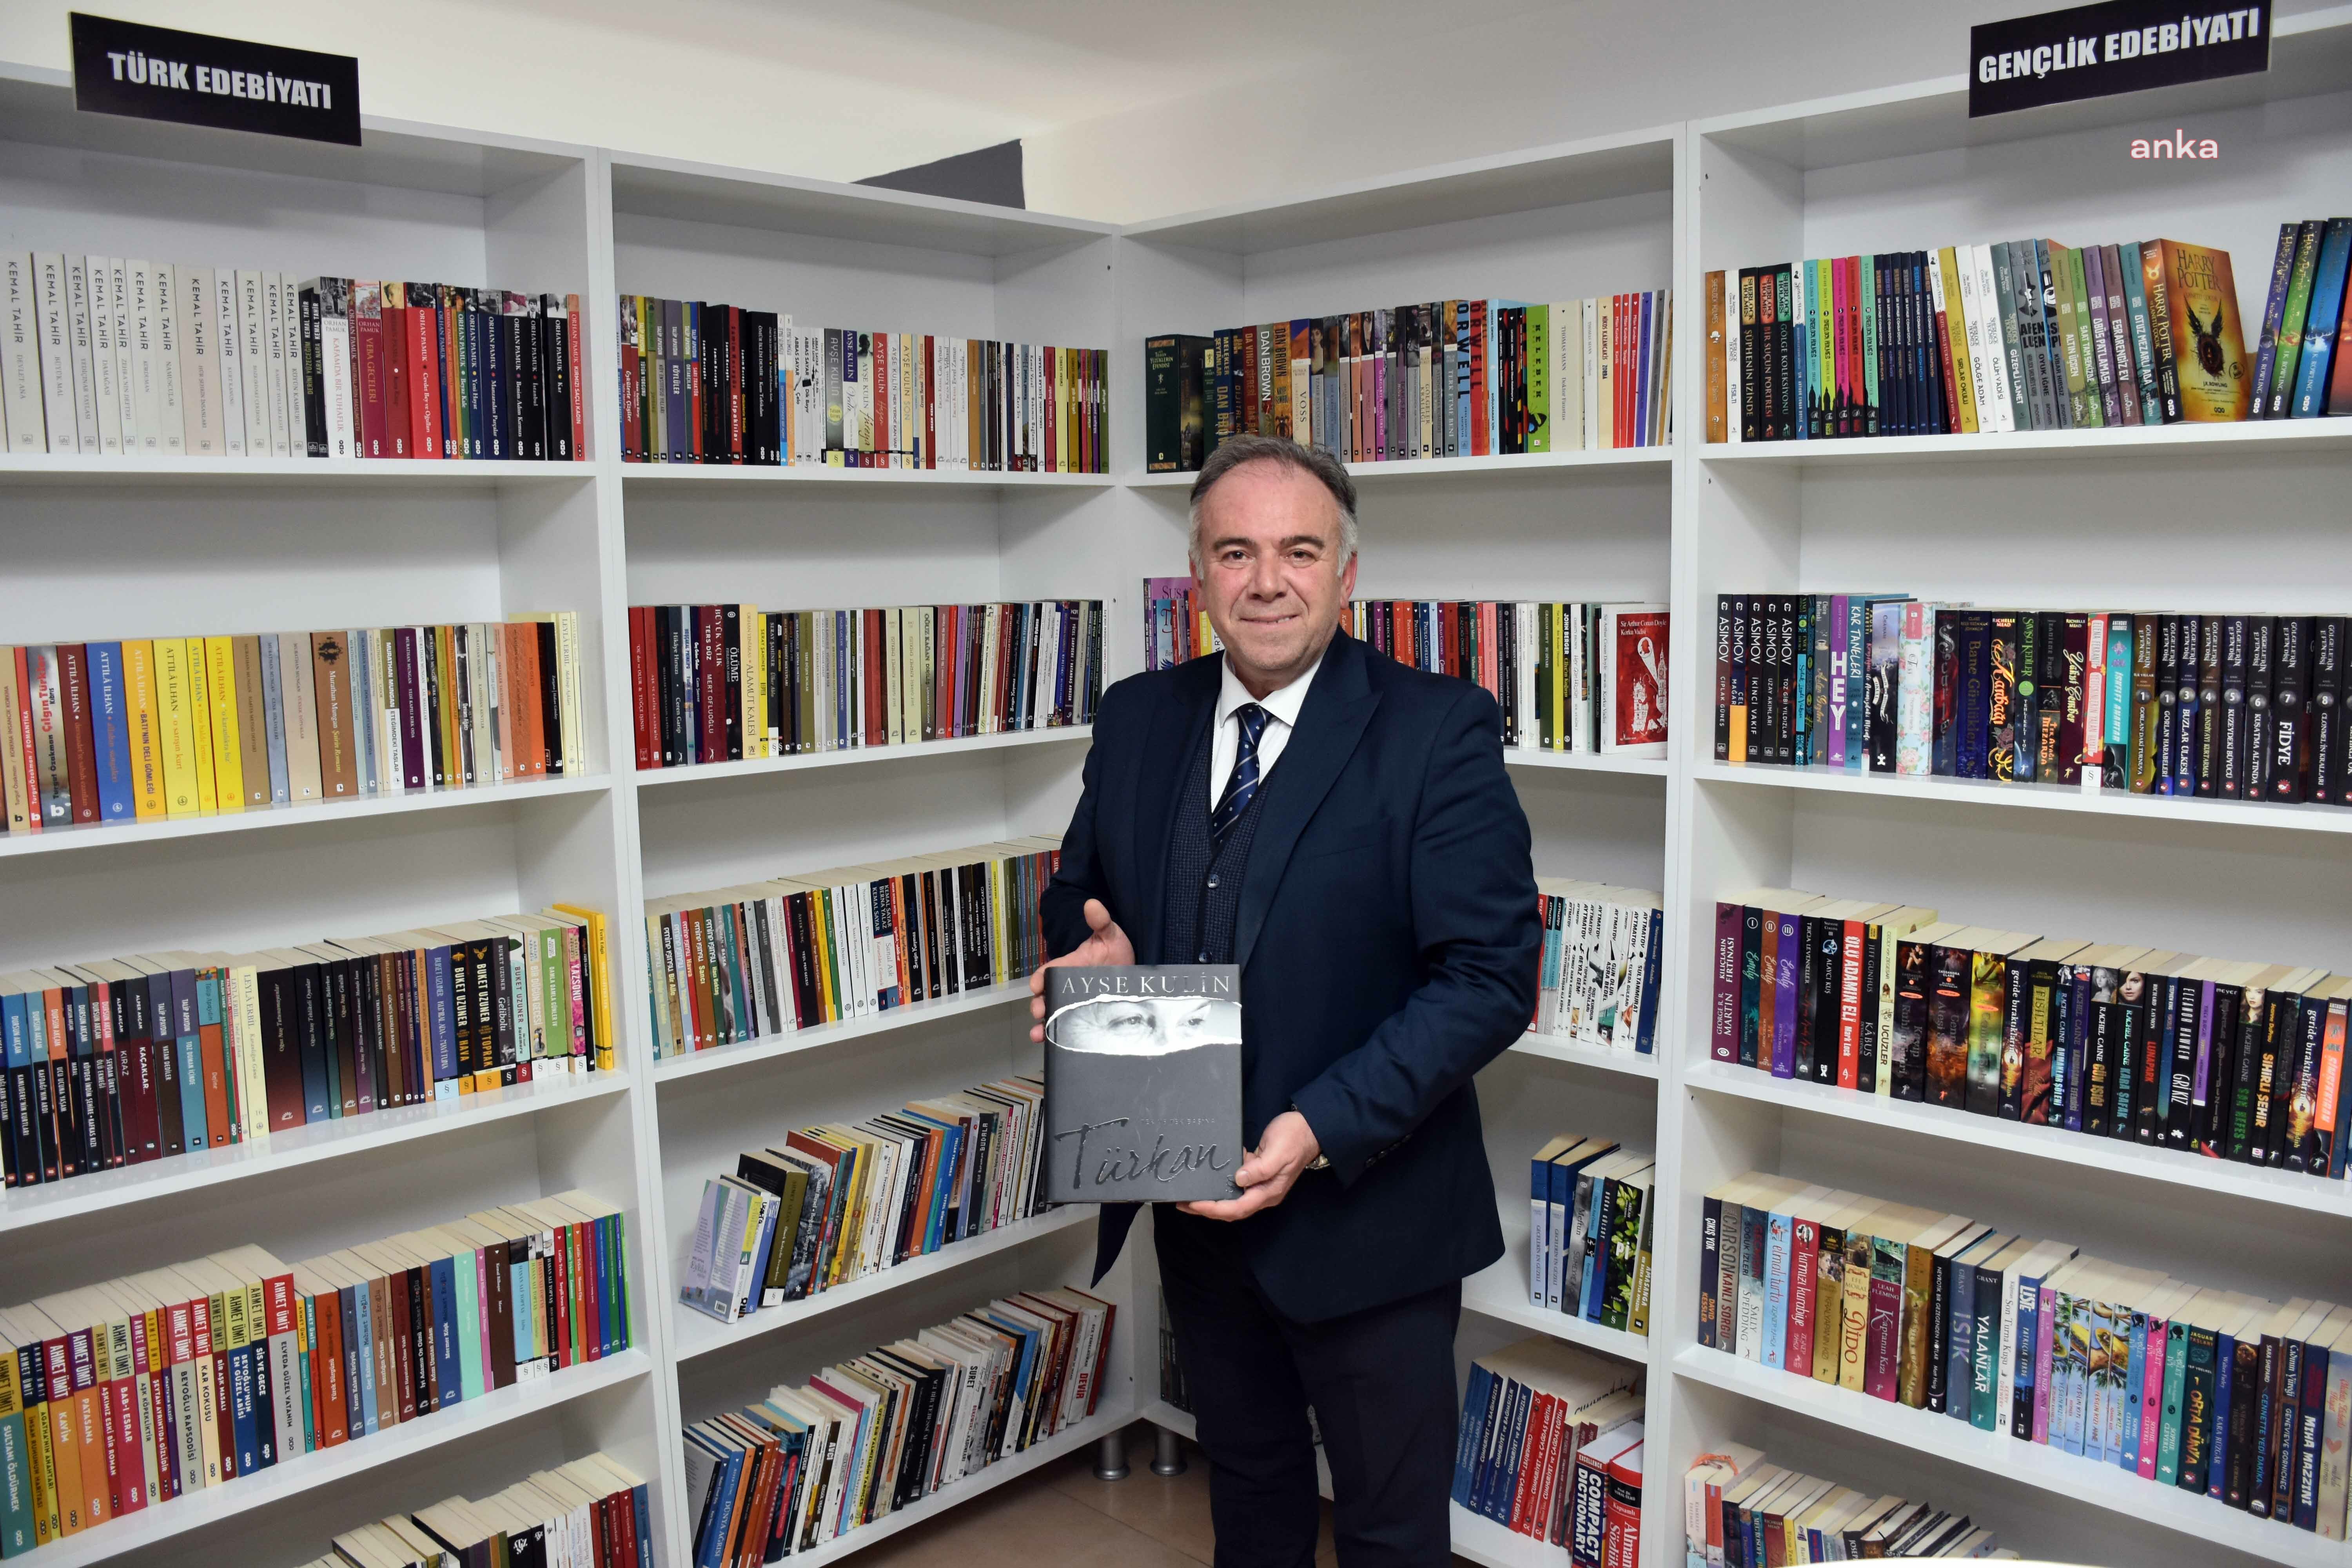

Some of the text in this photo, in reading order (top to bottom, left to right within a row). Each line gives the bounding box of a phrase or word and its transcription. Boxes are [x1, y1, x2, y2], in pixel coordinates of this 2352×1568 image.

[1979, 7, 2259, 83] GENÇLİK EDEBİYATI
[108, 51, 332, 109] TÜRK EDEBİYATI
[2178, 248, 2216, 274] HARRY
[2178, 271, 2223, 292] POTTER
[8, 261, 23, 343] KEMAL TAHİR
[158, 273, 171, 351] KEMAL TAHİR
[2153, 283, 2172, 362] HARRY POTTER
[1260, 331, 1271, 401] DAN BROWN
[1274, 328, 1287, 377] DAN BROWN
[1457, 303, 1469, 399] ORWELL
[1744, 330, 1754, 416] ŞÜPHENİN İZİNDE
[2111, 319, 2128, 381] ESRARENGİZ EV
[1719, 617, 1729, 663] ASIMOV
[1782, 619, 1791, 665] ASIMOV
[1850, 606, 1862, 678] KAR TANELERİ
[167, 647, 178, 711] ATTİLÂ İLHAN
[140, 713, 149, 744] BATI'NIN
[747, 706, 756, 737] KALESİ
[2180, 709, 2190, 775] BUZLAR ÜLKESİ
[2278, 721, 2295, 765] FİDYE
[143, 746, 152, 762] DELİ
[571, 963, 581, 1001] YAZSONU
[1140, 972, 1230, 993] KULİN
[1726, 937, 1735, 983] FIRTINASI
[1842, 959, 1859, 1003] ADAMIN
[1633, 965, 1643, 1013] SULTANMURAT
[454, 967, 469, 1062] BUKET UZUNER HAVA
[477, 964, 494, 1067] BUKET UZUNER TOPRAK
[498, 997, 506, 1032] Gelibolu
[2031, 991, 2046, 1055] FISILTILAR
[2098, 1006, 2106, 1035] RACHEL
[1843, 1026, 1852, 1057] Mark Lock
[2092, 1064, 2105, 1082] GÜN
[2118, 1068, 2131, 1091] KARA
[1054, 1117, 1232, 1190] Türkan
[1705, 1217, 1716, 1252] ÇIKIŞ YOK
[1872, 1287, 1899, 1300] FLEMING
[1877, 1283, 1895, 1293] LEAH
[1976, 1274, 1998, 1284] GRANT
[256, 1348, 264, 1361] SİS
[1844, 1309, 1865, 1364] DİDO
[1973, 1315, 1990, 1393] YALANLAR
[257, 1364, 264, 1372] VE
[967, 1366, 978, 1388] SURET
[1076, 1373, 1089, 1399] DEVİR
[58, 1412, 71, 1443] KAVİM
[184, 1412, 197, 1461] RAPSODİSİ
[2185, 1389, 2203, 1465] ORTA DÜNYA
[1579, 1455, 1602, 1468] EXCELLENCE
[2300, 1414, 2316, 1505] MIHA MAZZINI
[720, 1501, 731, 1529] DÜNYA
[1575, 1468, 1588, 1555] DICTIONARY
[1586, 1473, 1602, 1561] COMPACT
[1613, 1502, 1635, 1516] Kapsamlı
